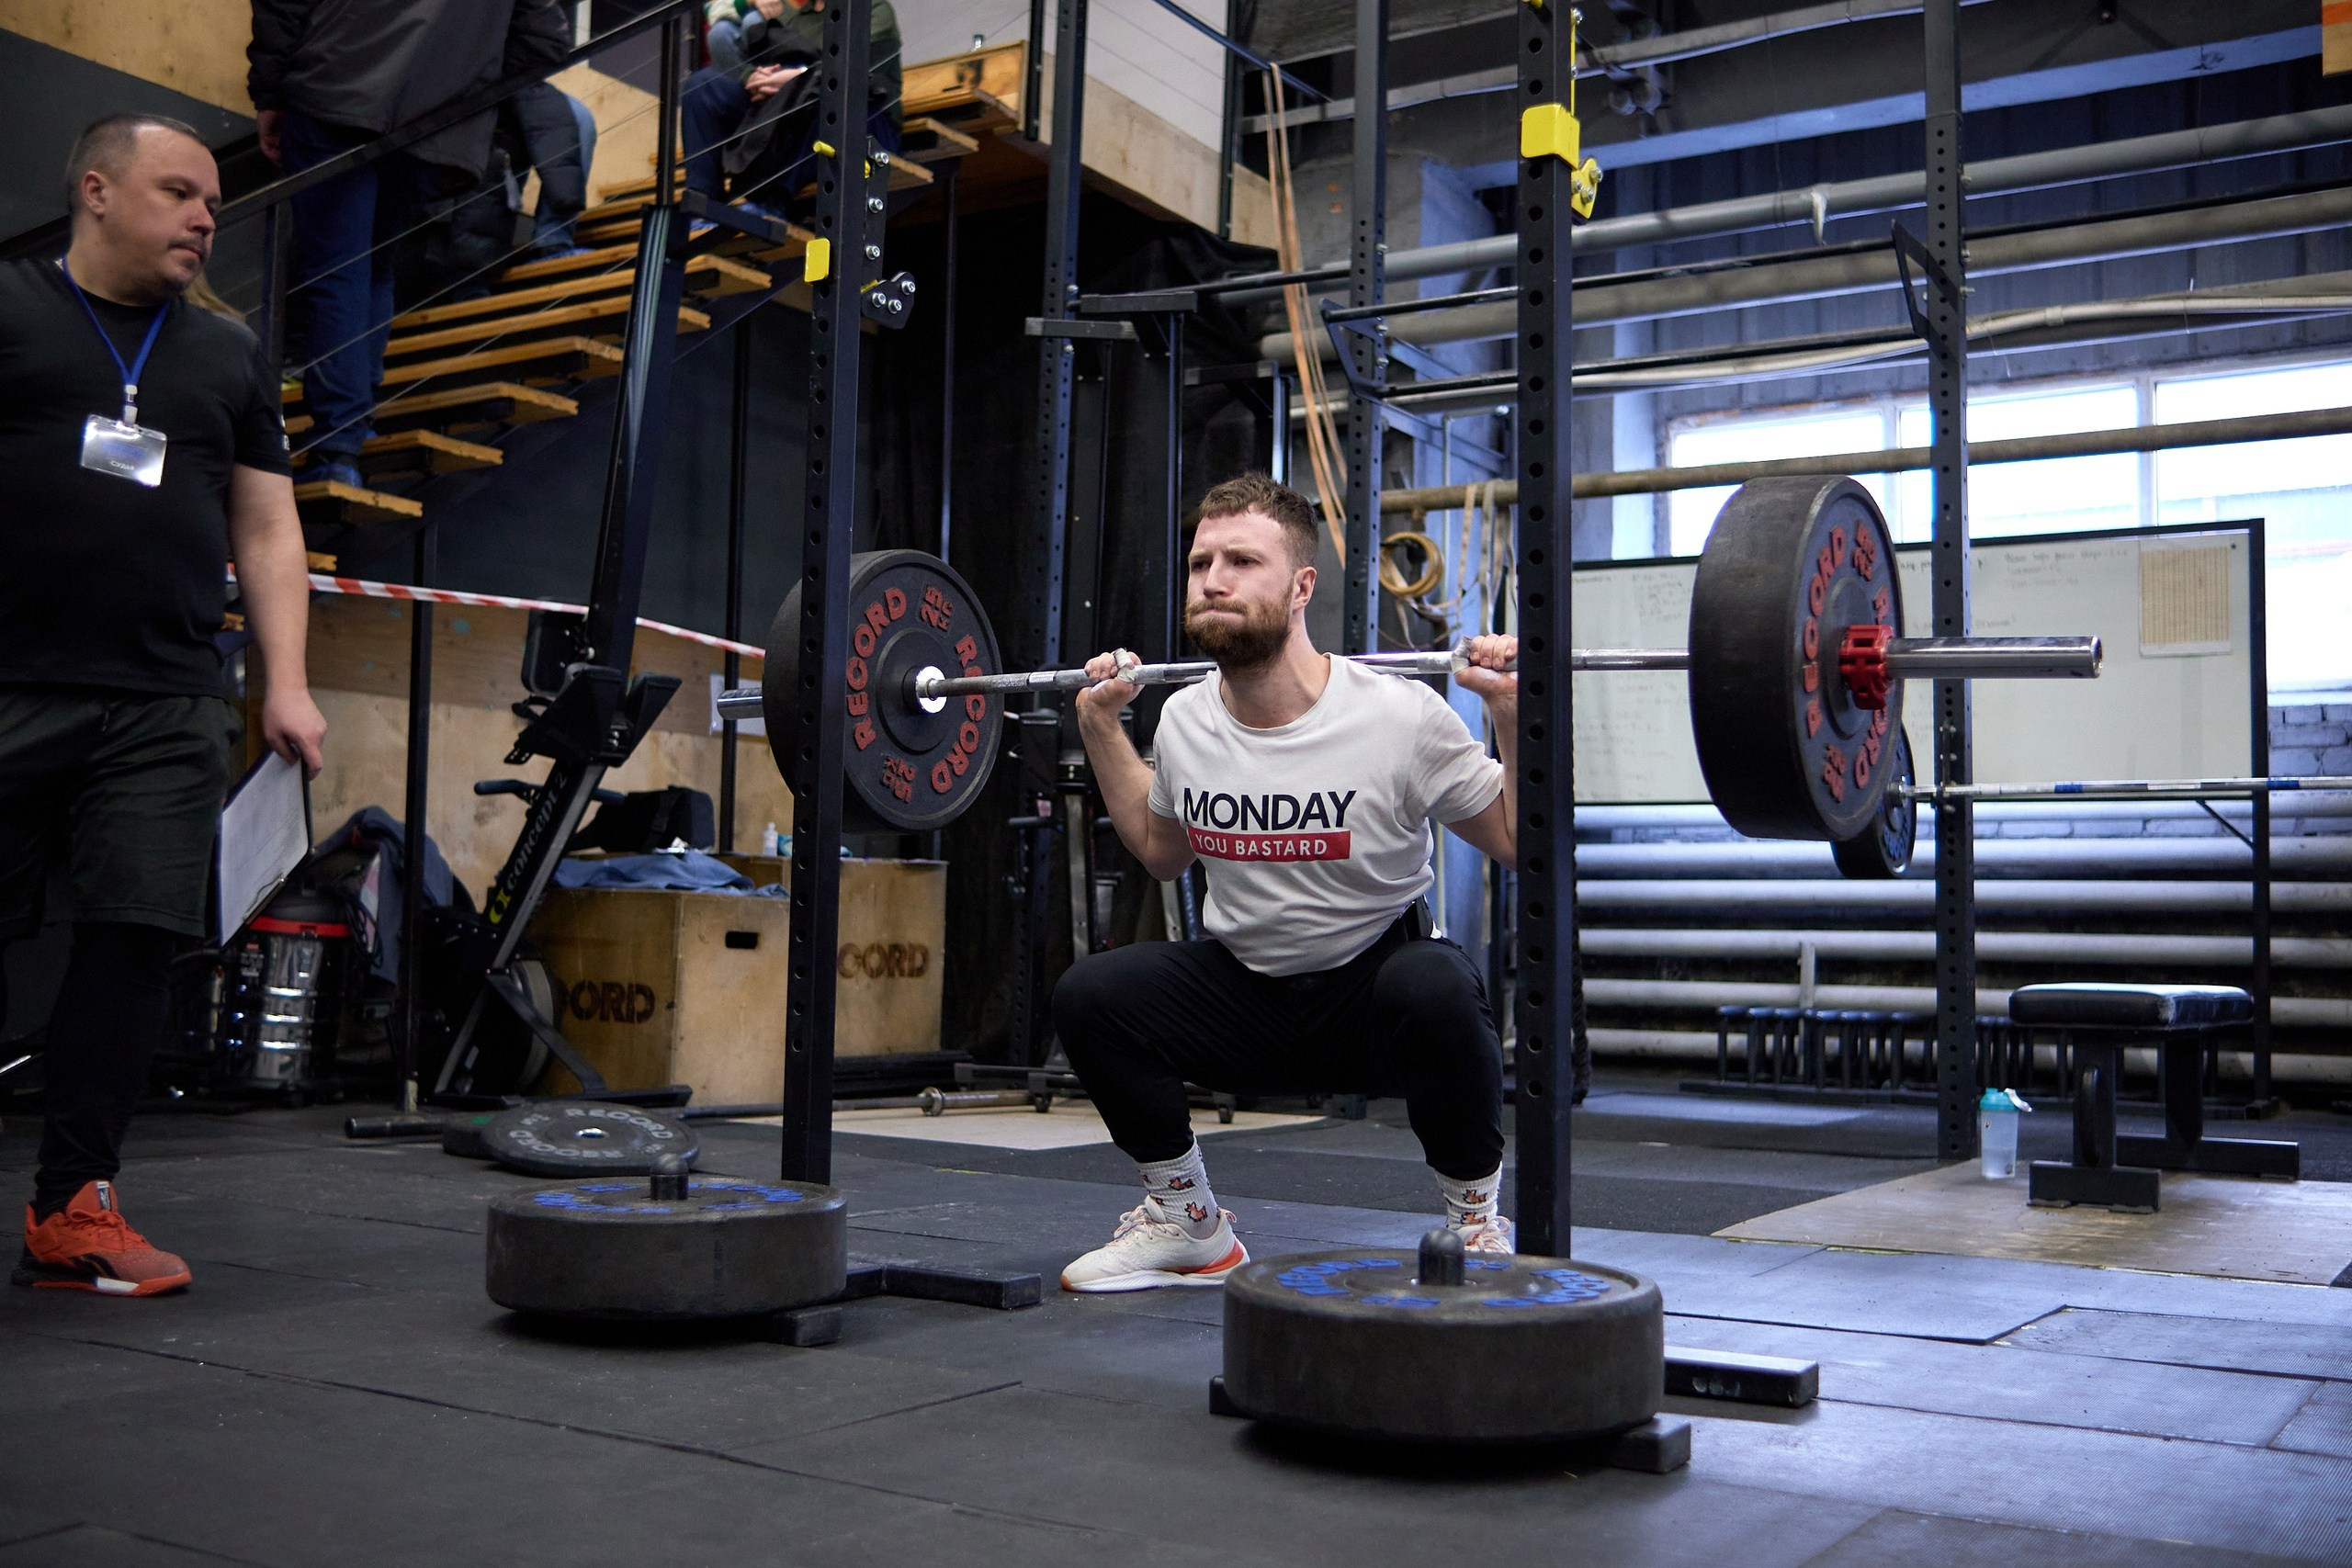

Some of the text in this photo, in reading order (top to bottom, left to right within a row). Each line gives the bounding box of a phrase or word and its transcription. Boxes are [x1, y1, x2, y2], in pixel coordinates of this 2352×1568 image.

[1802, 526, 1847, 738] RECORD
[846, 588, 907, 750] RECORD
[1183, 787, 1357, 830] MONDAY
[1194, 832, 1329, 857] YOU BASTARD
[564, 1108, 673, 1139] RECORD
[509, 1130, 625, 1158] RECORD
[1275, 1258, 1403, 1296] RECORD
[1481, 1269, 1611, 1308] RECORD
